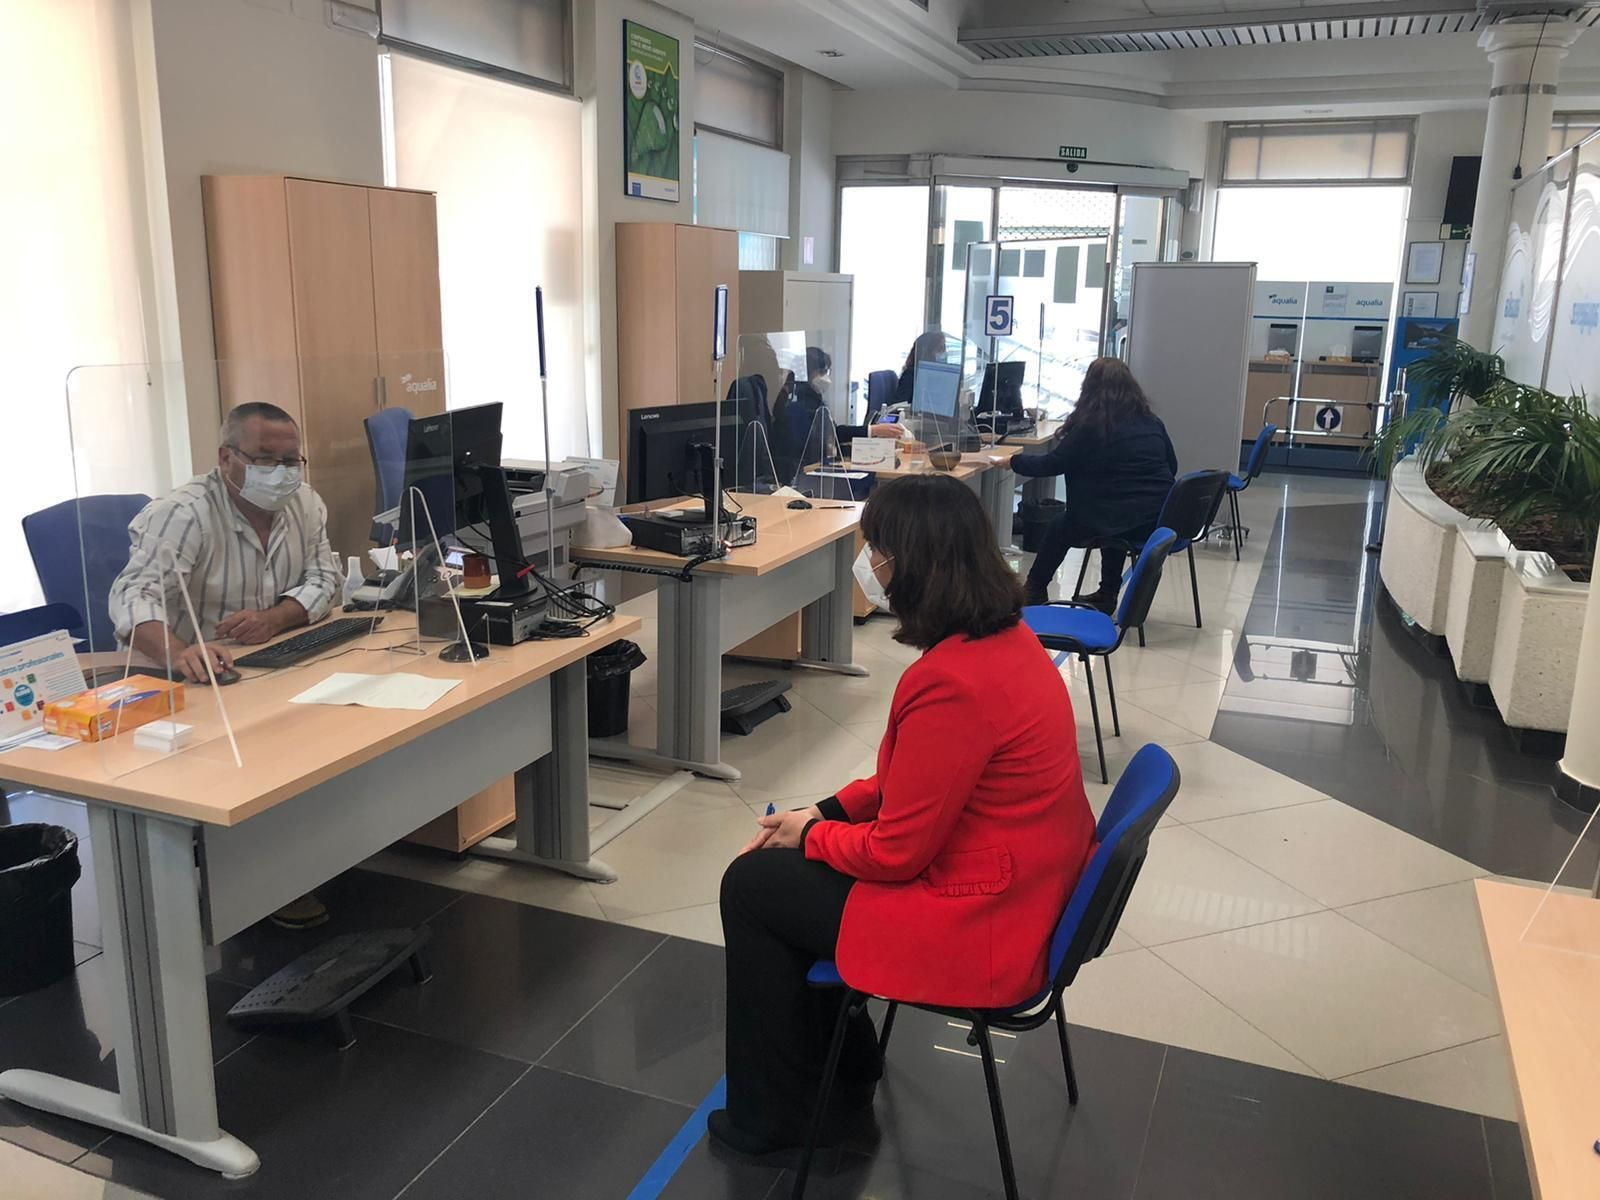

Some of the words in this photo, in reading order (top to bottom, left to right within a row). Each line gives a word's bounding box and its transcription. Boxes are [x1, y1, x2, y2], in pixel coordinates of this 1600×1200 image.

[1060, 147, 1086, 158] SALIDA
[1272, 296, 1298, 306] aqualia
[1355, 298, 1383, 308] aqualia
[989, 300, 1010, 331] 5
[406, 377, 437, 395] aqualia
